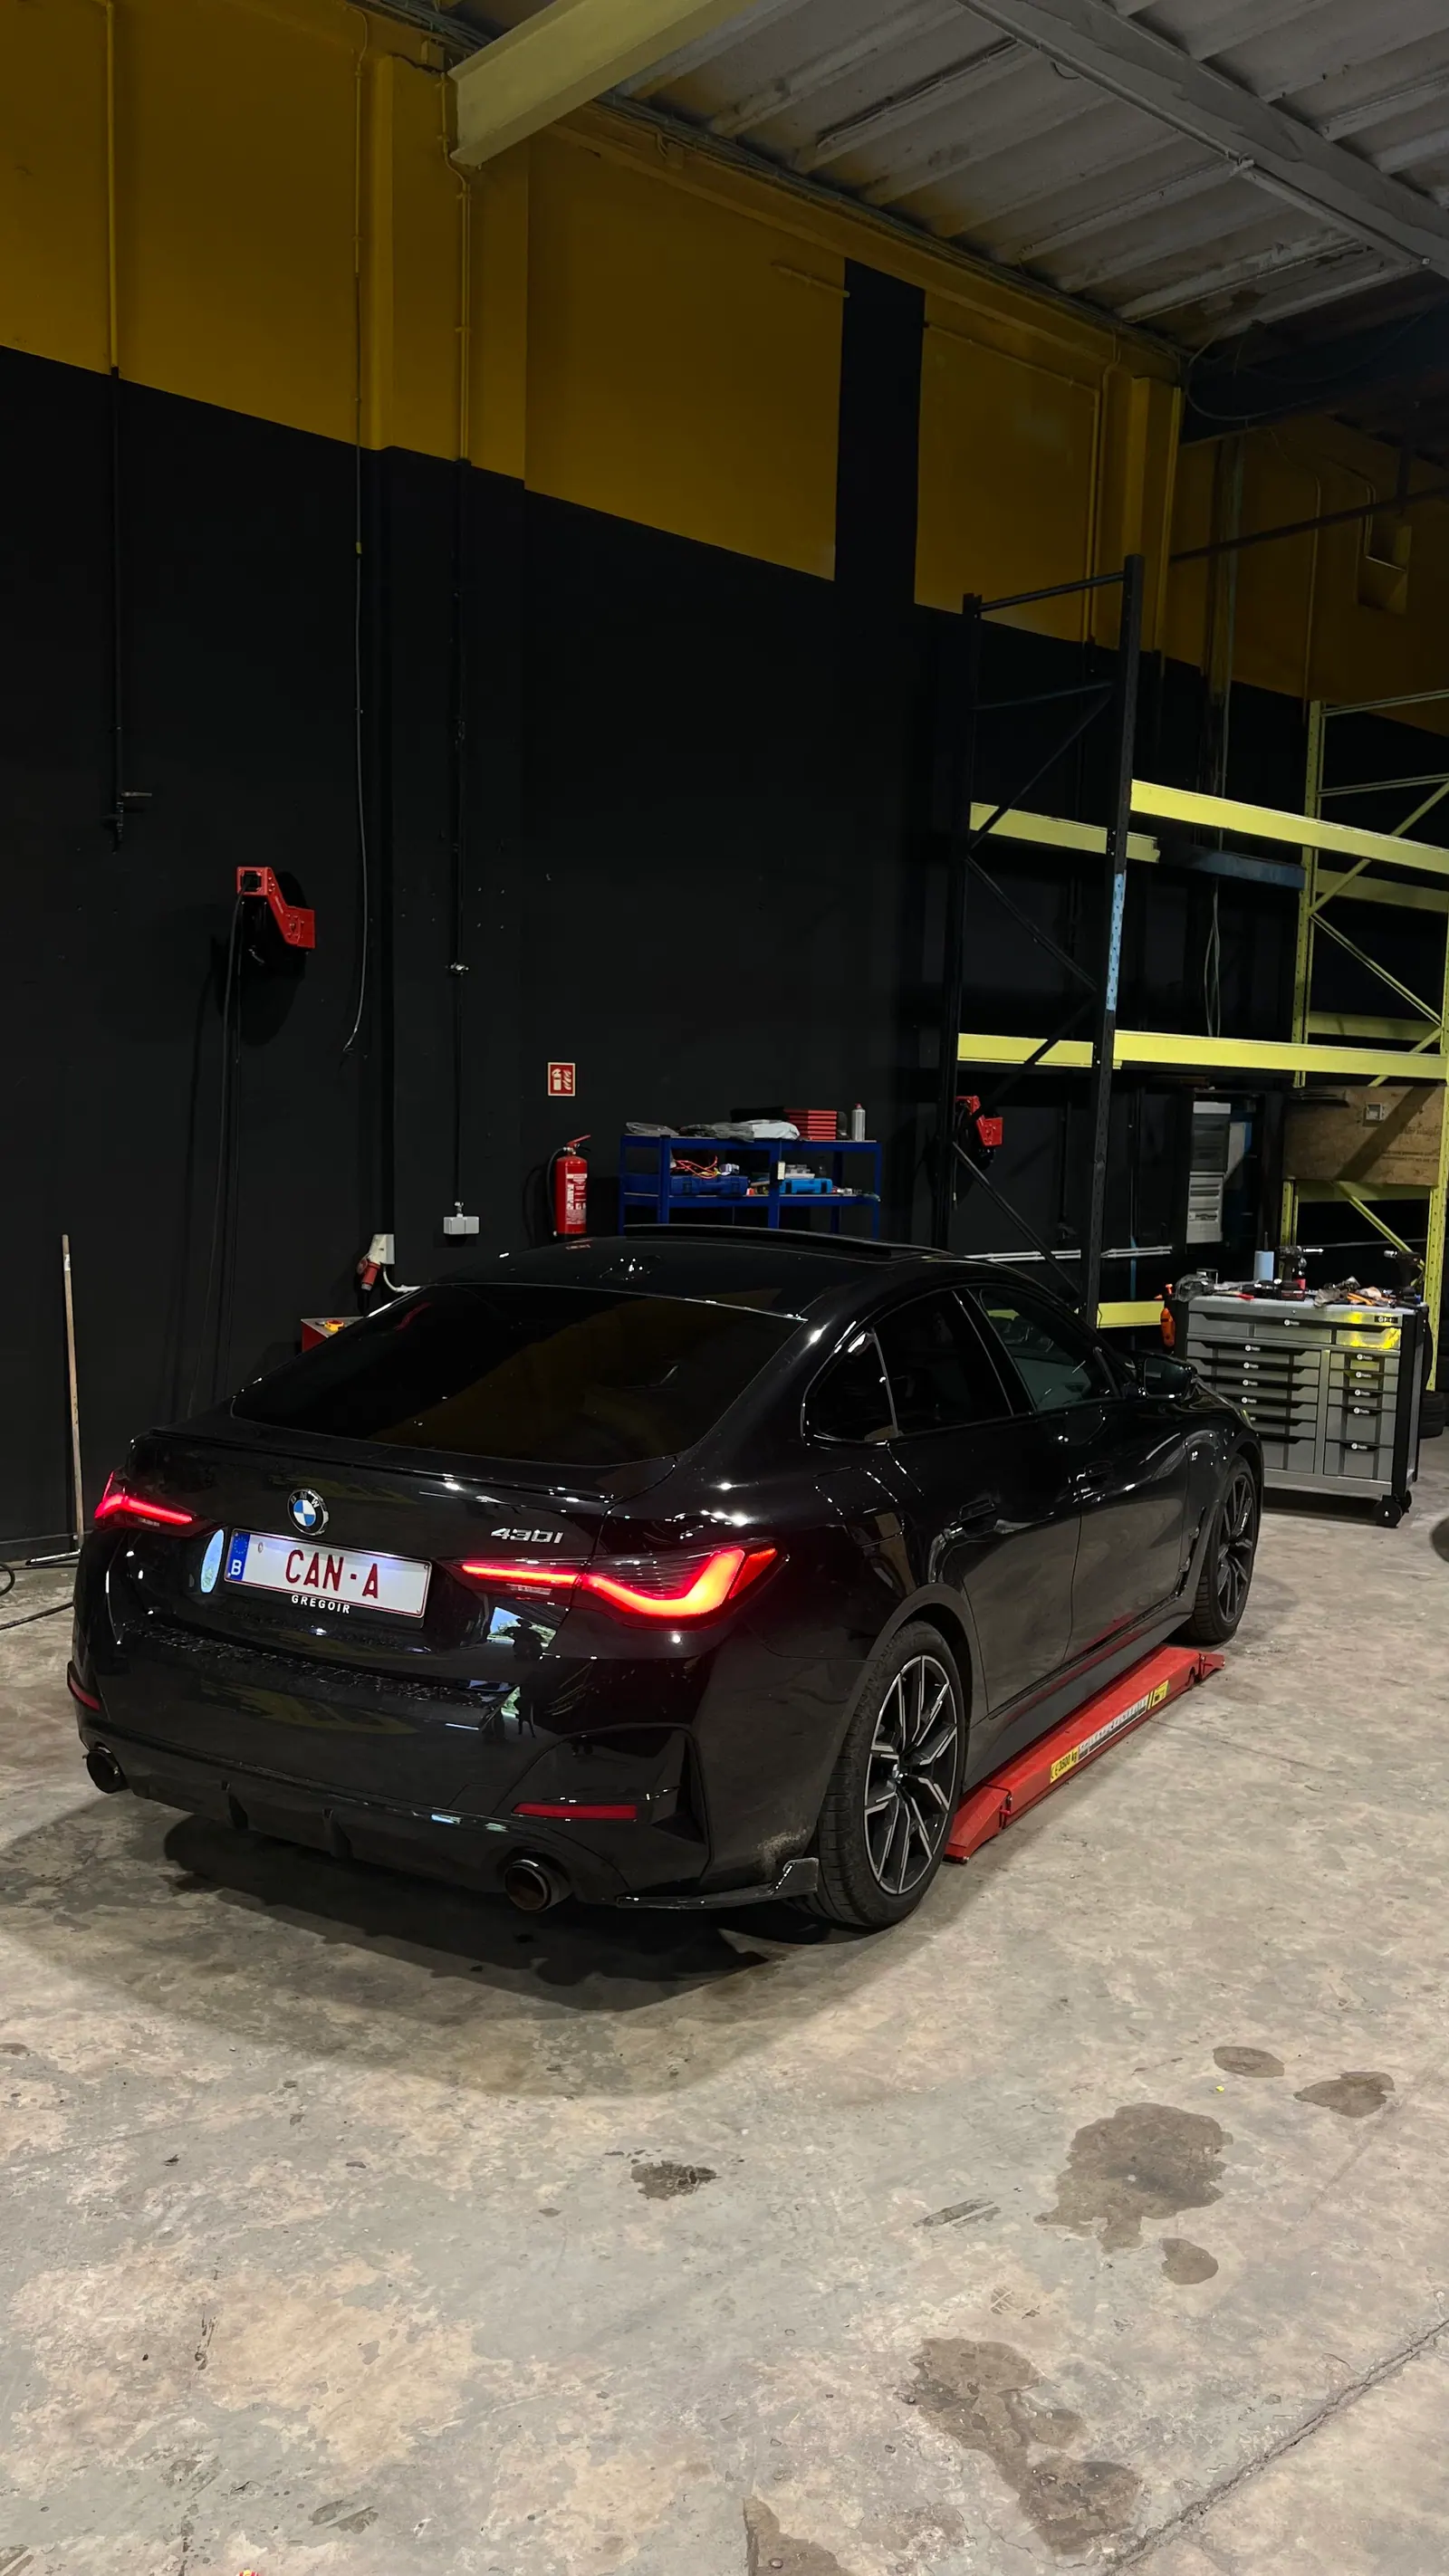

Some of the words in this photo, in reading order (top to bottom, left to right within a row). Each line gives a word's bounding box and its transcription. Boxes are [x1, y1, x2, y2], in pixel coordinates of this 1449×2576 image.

[290, 1490, 321, 1508] BMW
[231, 1559, 243, 1575] B
[291, 1594, 350, 1614] GREGOIR
